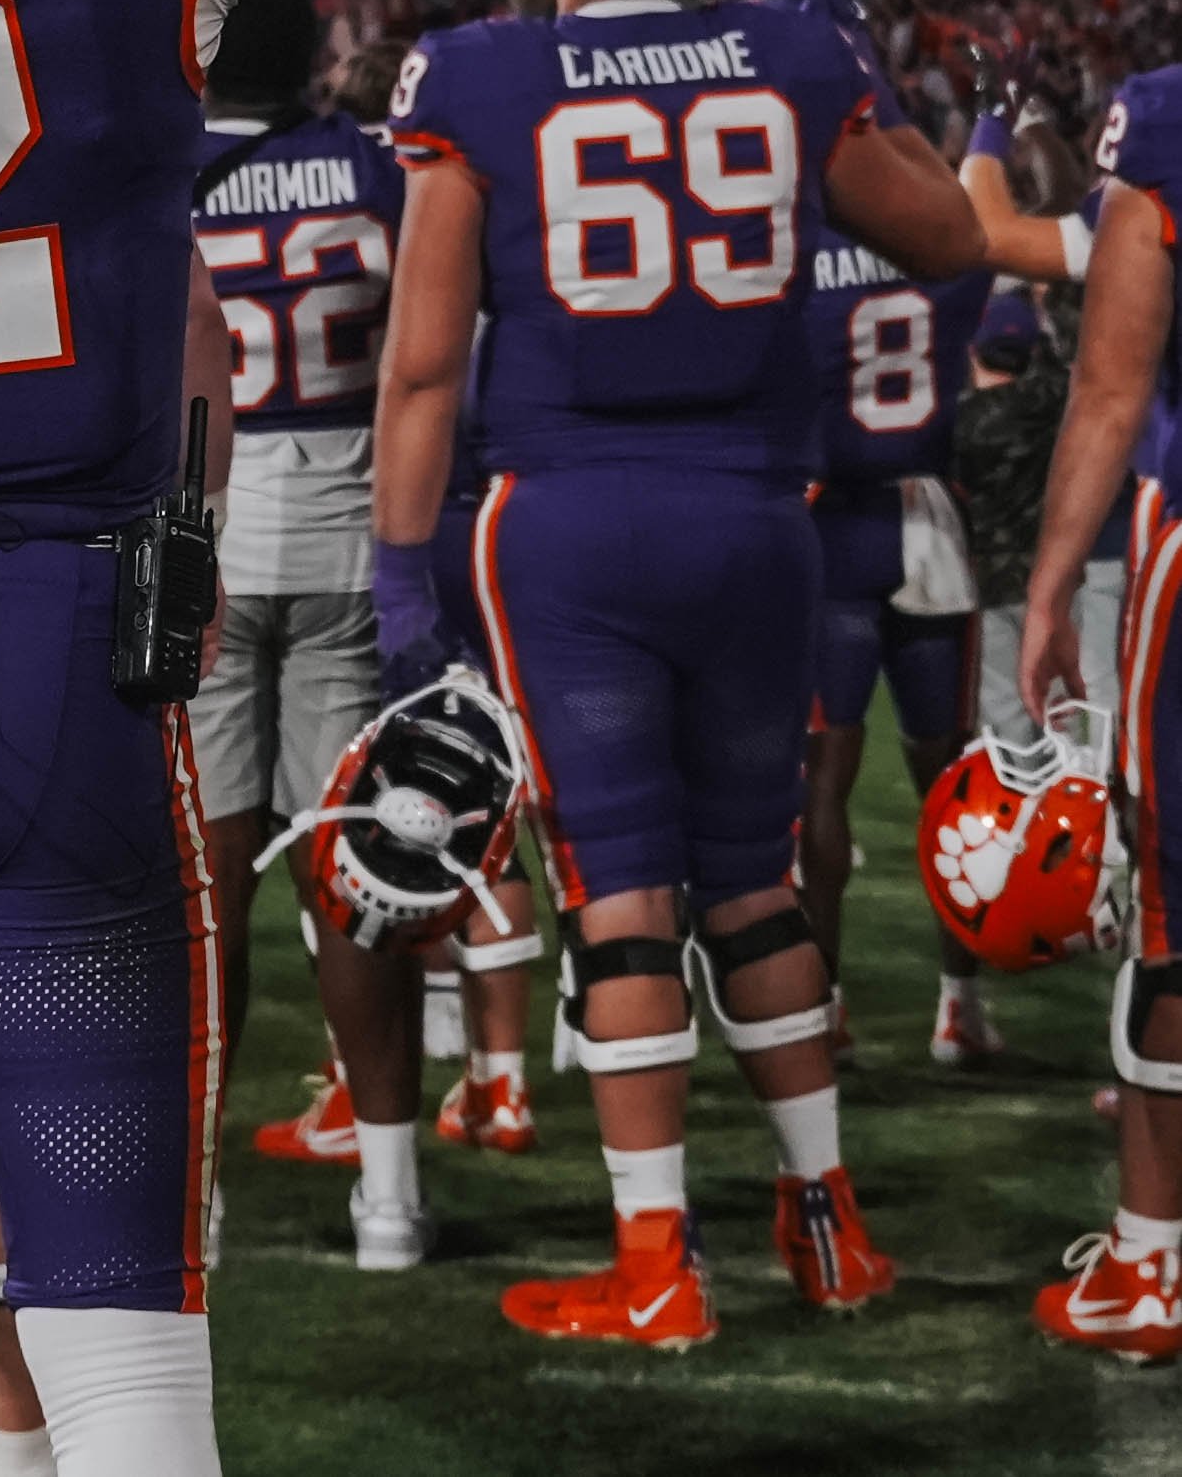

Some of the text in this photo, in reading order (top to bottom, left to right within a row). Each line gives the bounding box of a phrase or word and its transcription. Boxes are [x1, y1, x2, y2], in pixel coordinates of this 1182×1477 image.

[559, 31, 756, 89] CARDONE
[192, 157, 358, 217] HURMON
[533, 86, 801, 317] 69
[847, 287, 939, 433] 8
